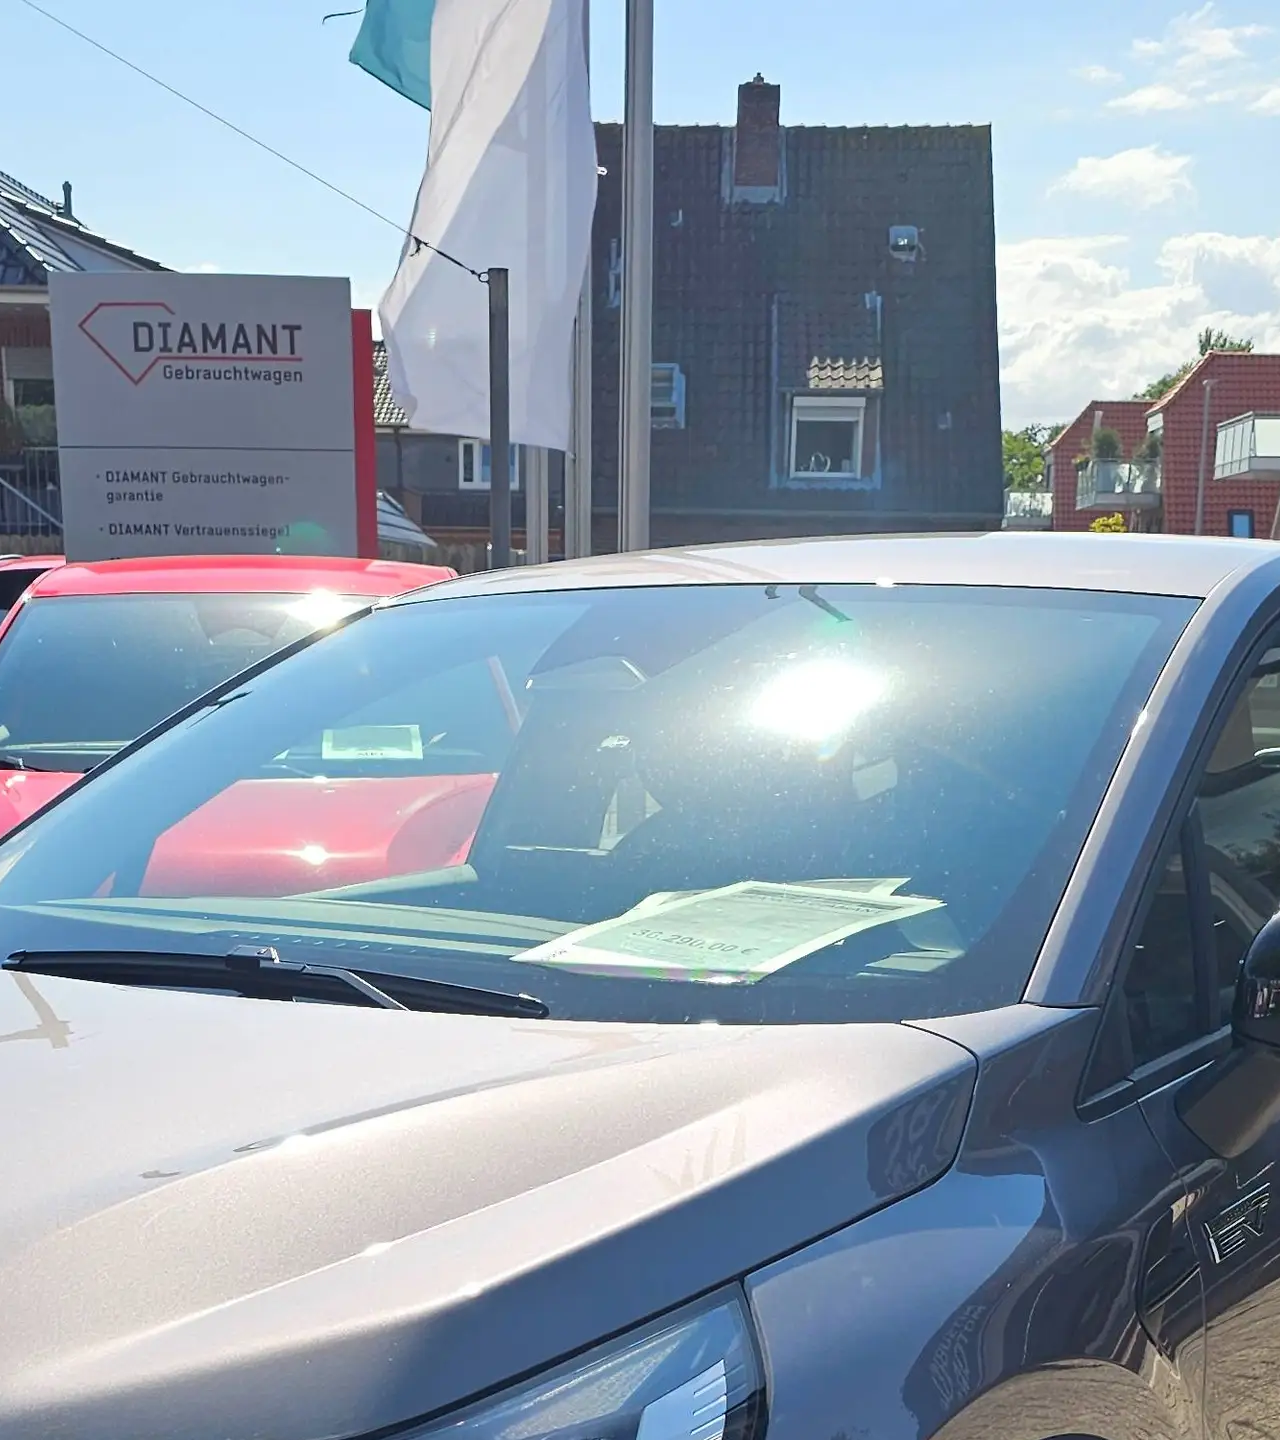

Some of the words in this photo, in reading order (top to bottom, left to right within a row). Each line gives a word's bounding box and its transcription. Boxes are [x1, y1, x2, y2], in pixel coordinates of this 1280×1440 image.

[133, 321, 303, 356] DIAMANT
[162, 364, 303, 386] Gebrauchtwagen
[105, 470, 168, 484] DIAMANT
[172, 471, 290, 487] Gebrauchtwagen-
[106, 489, 164, 504] garantie
[108, 523, 170, 537] DIAMANT
[174, 524, 291, 540] Vertrauenssiegel
